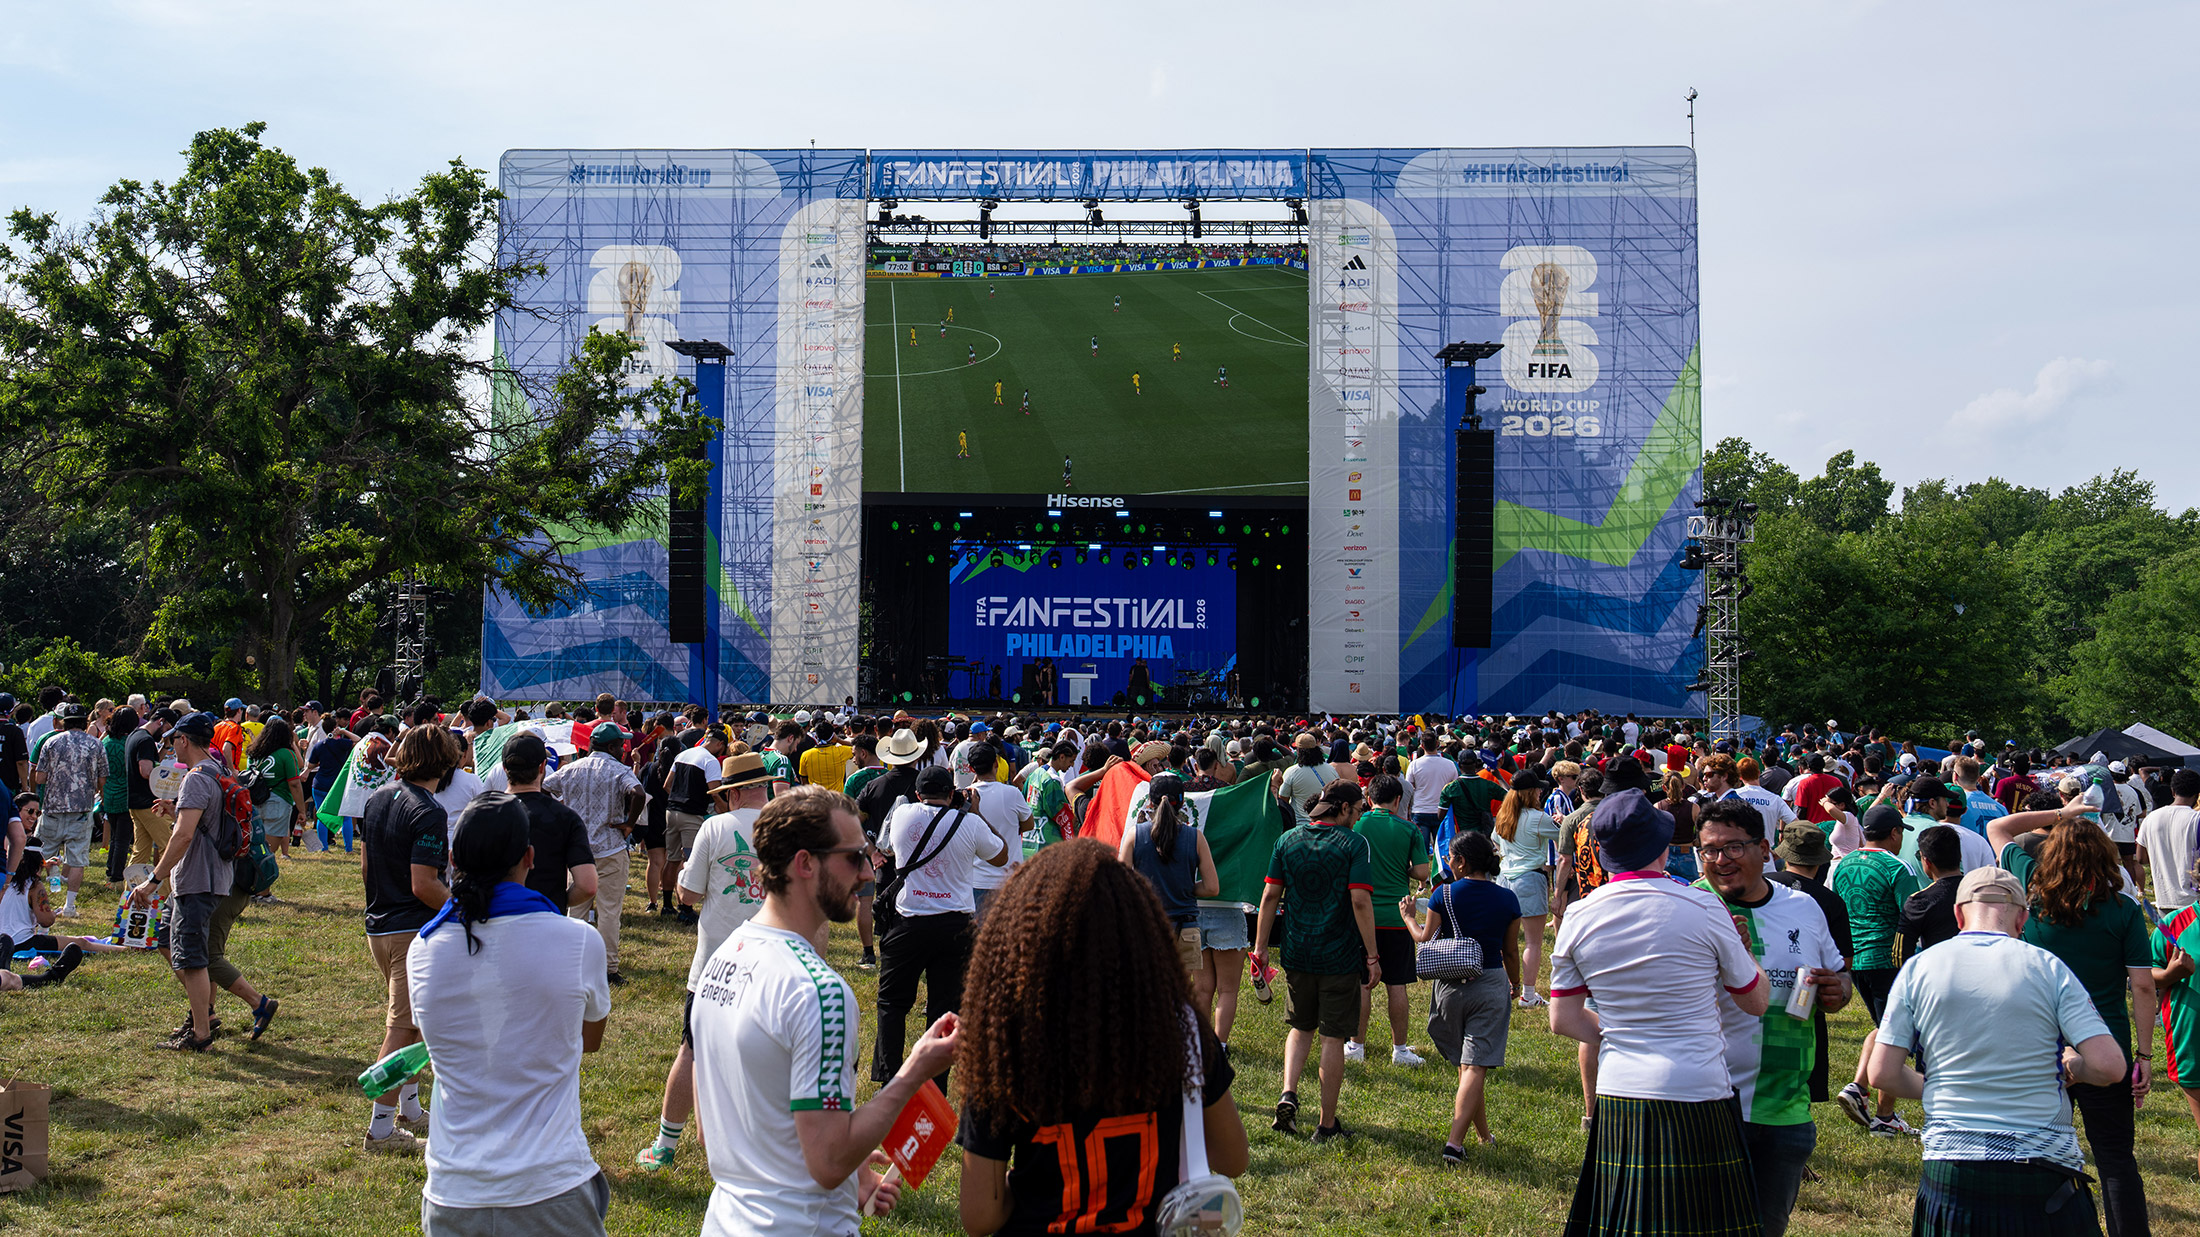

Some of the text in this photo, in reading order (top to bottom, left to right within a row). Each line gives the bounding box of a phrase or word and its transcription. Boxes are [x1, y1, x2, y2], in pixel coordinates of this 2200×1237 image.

[570, 165, 711, 188] #FIFAWorldCup
[883, 161, 893, 186] FIFA
[1072, 161, 1080, 185] 2026
[1093, 160, 1294, 187] PHILADELPHIA
[1463, 162, 1629, 184] #FIFAFanFestival
[1171, 261, 1189, 269] VISA
[1213, 259, 1231, 267] VISA
[1256, 257, 1274, 265] VISA
[1293, 260, 1305, 270] VISA
[888, 263, 909, 271] 77:02
[936, 263, 1000, 271] MEX 2 0 RSA
[1042, 267, 1061, 275] VISA
[1086, 265, 1104, 273] VISA
[1128, 264, 1147, 272] VISA
[814, 277, 836, 286] ADI
[1347, 278, 1370, 287] ADI
[804, 343, 835, 352] Lenovo
[1339, 347, 1371, 355] Lenovo
[624, 359, 654, 374] IFA
[804, 362, 834, 372] QATAR
[1339, 366, 1370, 376] QATAR
[1528, 363, 1572, 378] FIFA
[807, 386, 834, 397] VISA
[1341, 390, 1371, 400] VISA
[1501, 399, 1600, 412] WORLD CUP
[1501, 415, 1600, 437] 2026
[1047, 493, 1124, 508] Hisense
[976, 596, 986, 626] FIFA
[1197, 599, 1206, 629] 2026
[1006, 632, 1174, 659] PHILADELPHIA
[2015, 782, 2034, 793] HENRY
[1970, 800, 1998, 811] DE BRUYNE
[749, 884, 767, 900] CU
[701, 957, 737, 984] pure
[701, 983, 736, 1007] energie
[1, 1106, 24, 1176] VISA
[1031, 1112, 1159, 1234] 10
